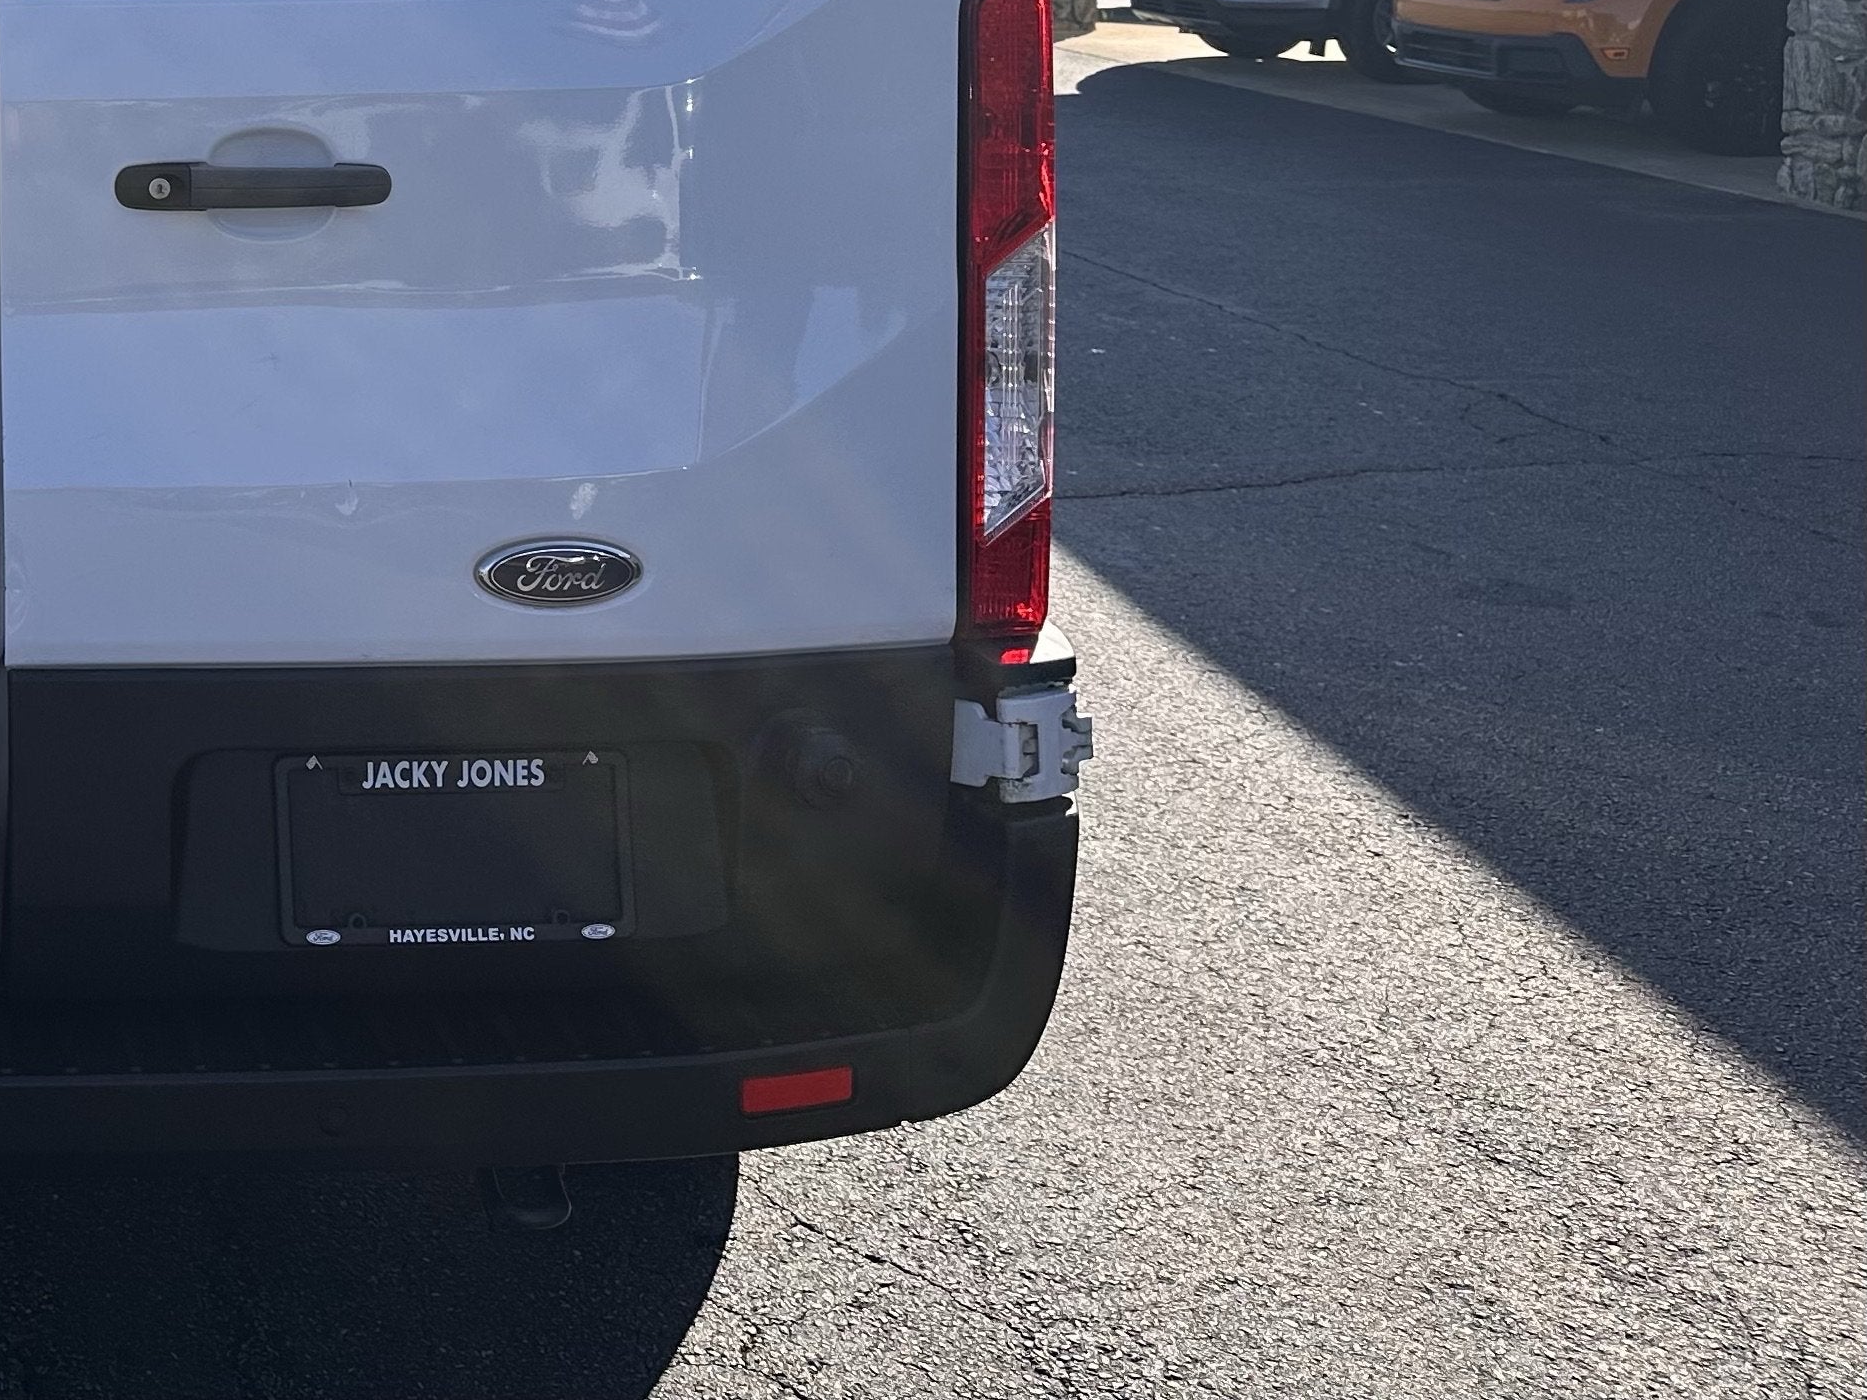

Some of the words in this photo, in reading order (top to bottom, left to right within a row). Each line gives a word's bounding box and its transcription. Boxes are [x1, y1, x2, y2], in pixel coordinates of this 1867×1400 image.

[516, 554, 606, 592] Ford
[362, 760, 449, 790] JACKY
[456, 758, 546, 788] JONES
[389, 928, 505, 943] HAYESVILLE,
[510, 926, 535, 941] NC
